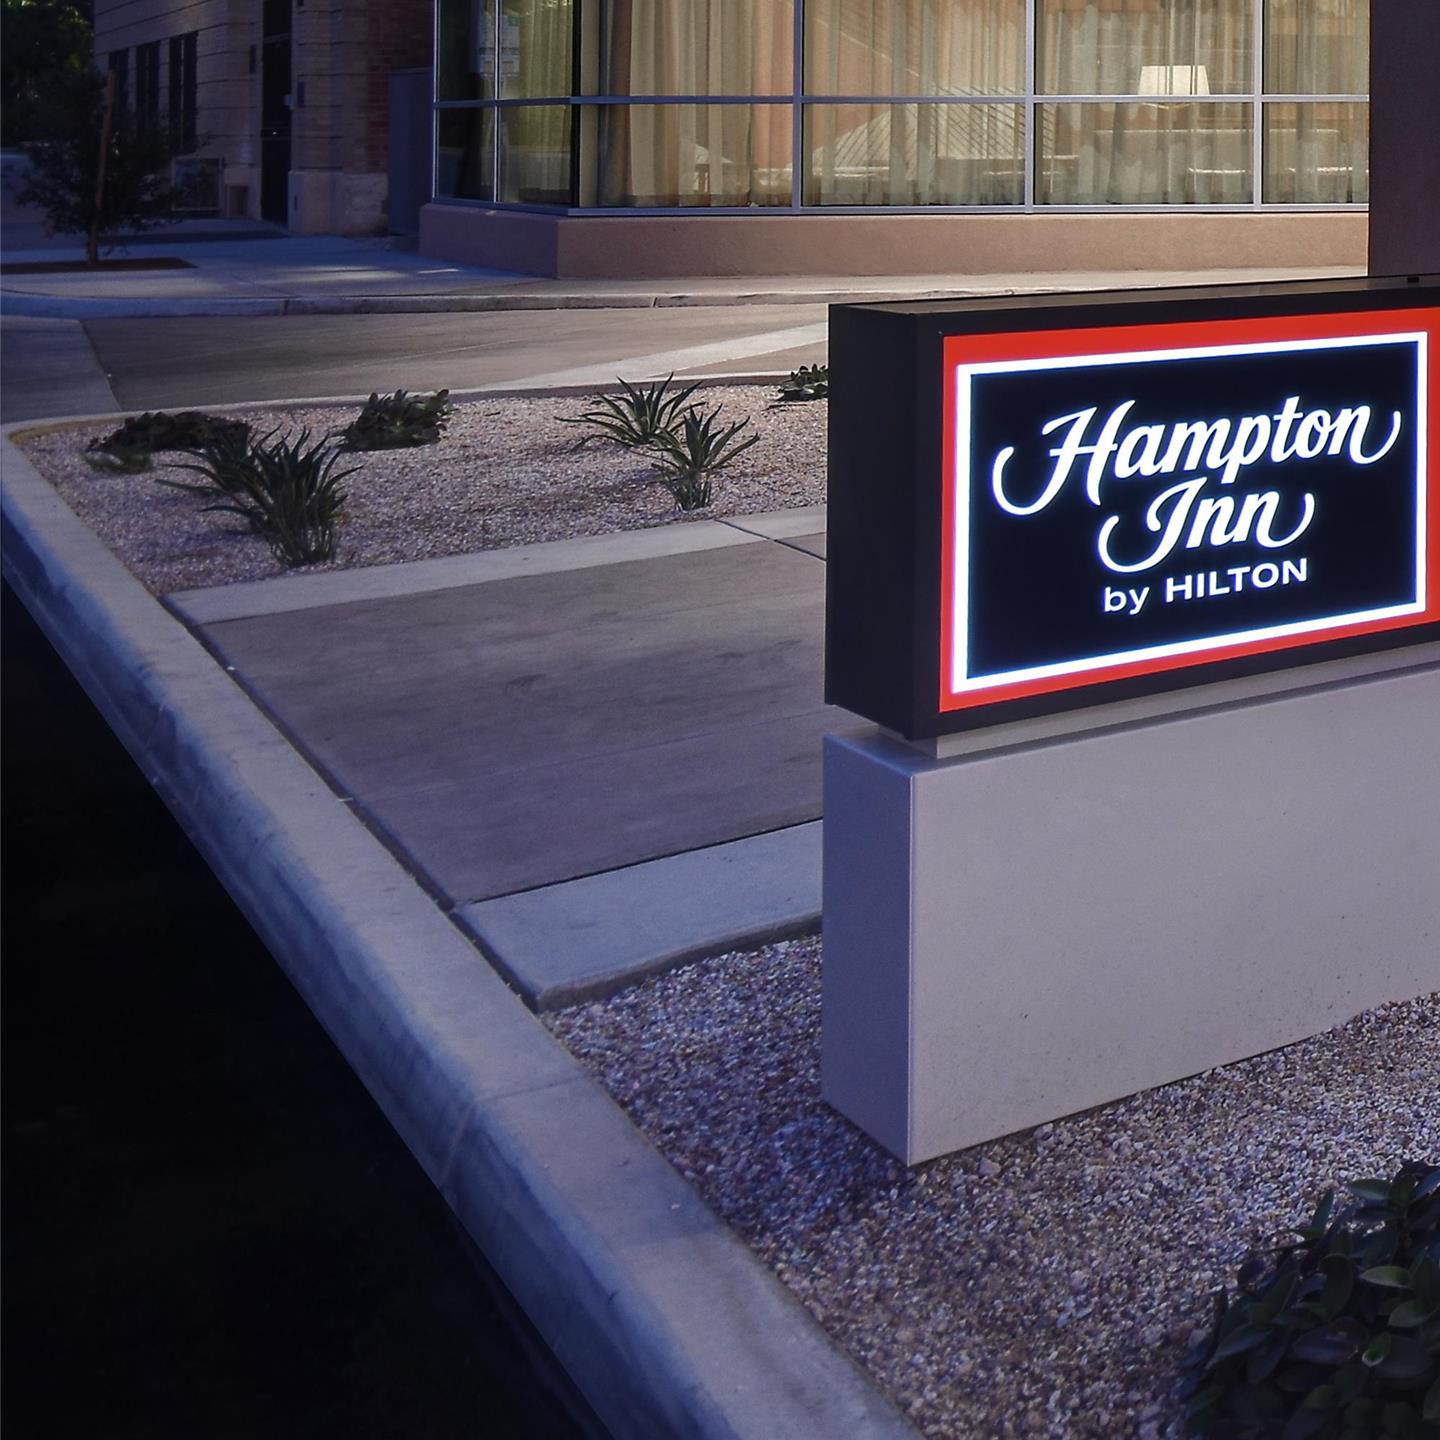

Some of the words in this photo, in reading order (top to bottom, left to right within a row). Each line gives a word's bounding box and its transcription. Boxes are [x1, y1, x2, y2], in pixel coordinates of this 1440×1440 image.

[992, 396, 1401, 516] Hampton
[1098, 476, 1315, 573] Inn
[1104, 586, 1150, 615] by
[1166, 558, 1308, 603] HILTON
